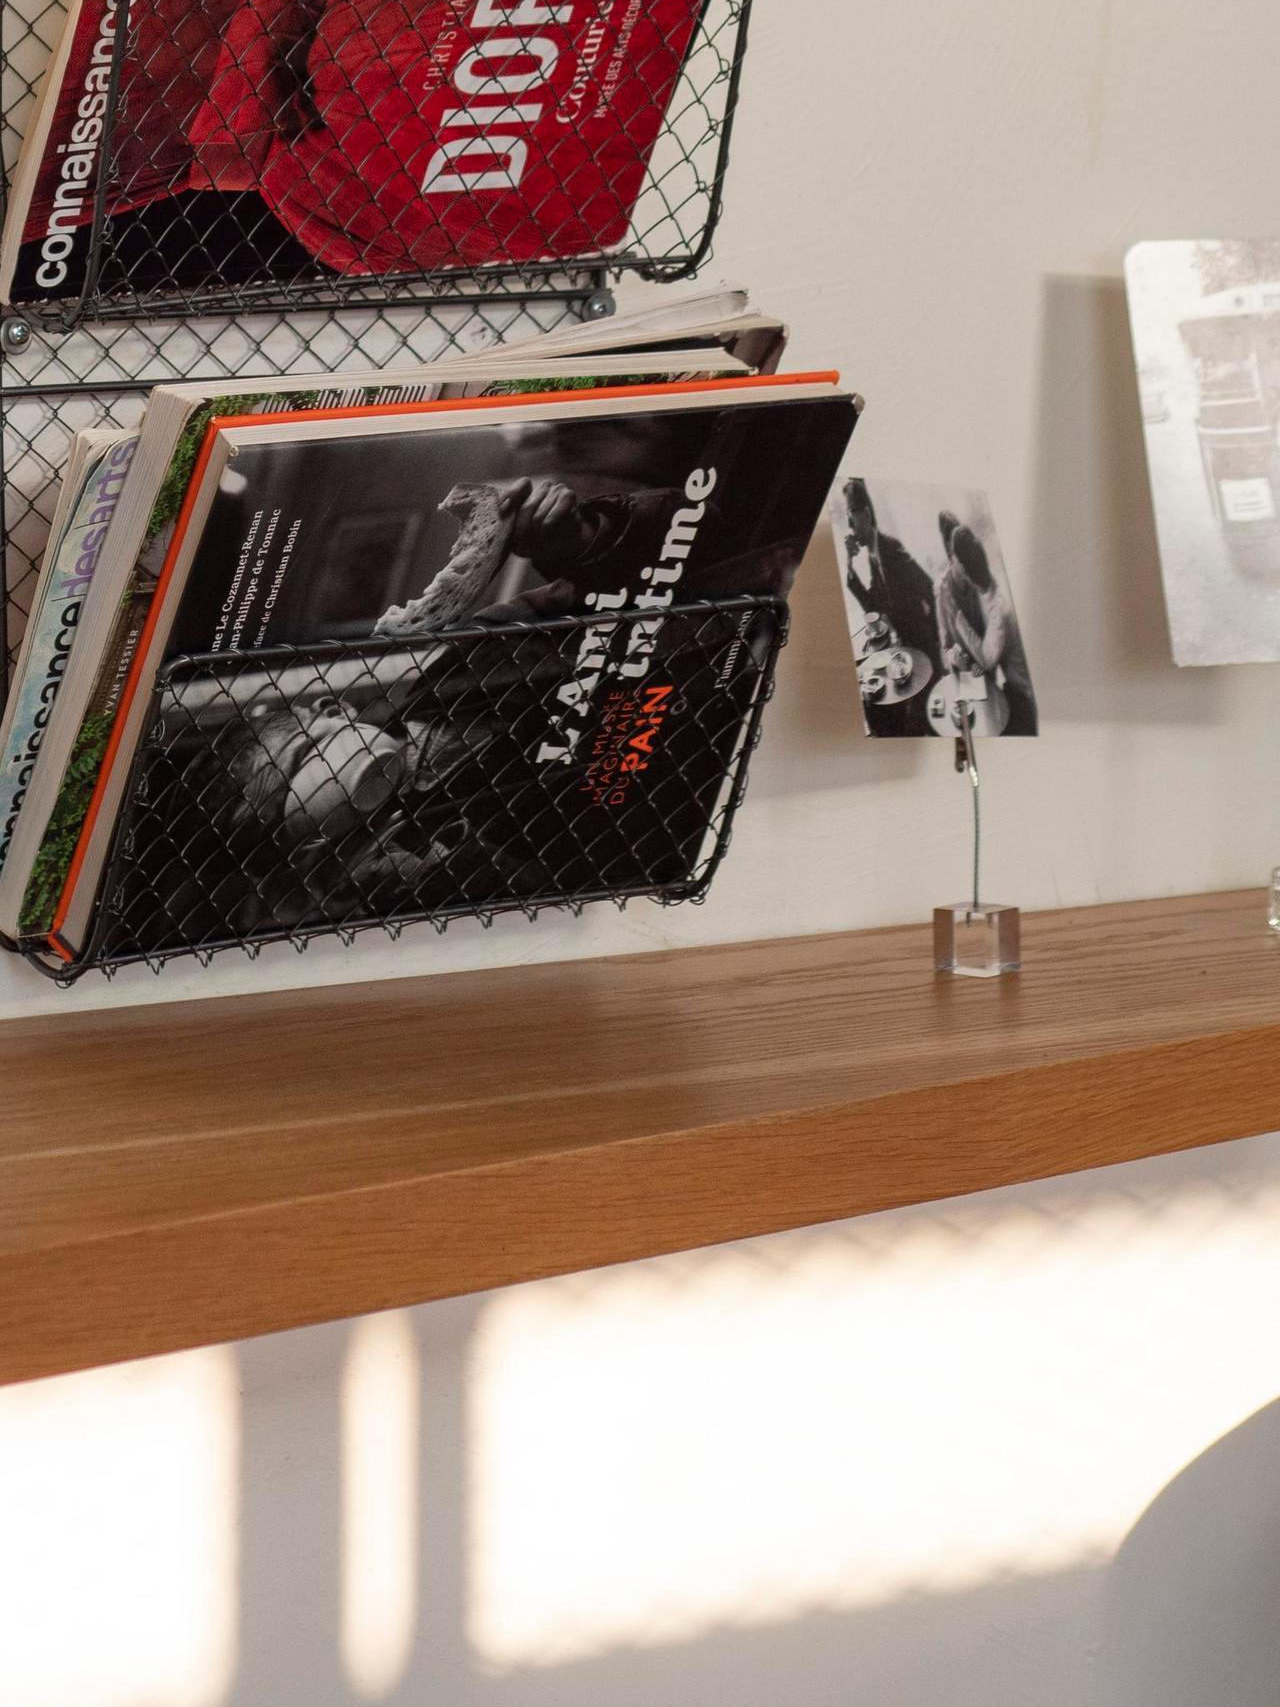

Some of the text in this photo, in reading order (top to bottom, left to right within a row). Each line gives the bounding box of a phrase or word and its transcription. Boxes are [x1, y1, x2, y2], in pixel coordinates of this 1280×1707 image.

[604, 60, 622, 83] DES
[222, 509, 264, 613] Cozannet-Renan
[282, 519, 302, 556] Bobin
[229, 507, 282, 650] an-Philippe de Tonnac
[264, 555, 290, 610] Christian
[607, 466, 718, 682] intime
[216, 615, 230, 630] Le
[261, 610, 272, 625] de
[103, 629, 139, 717] YVAN TESSIER
[609, 685, 675, 805] DU PAIN
